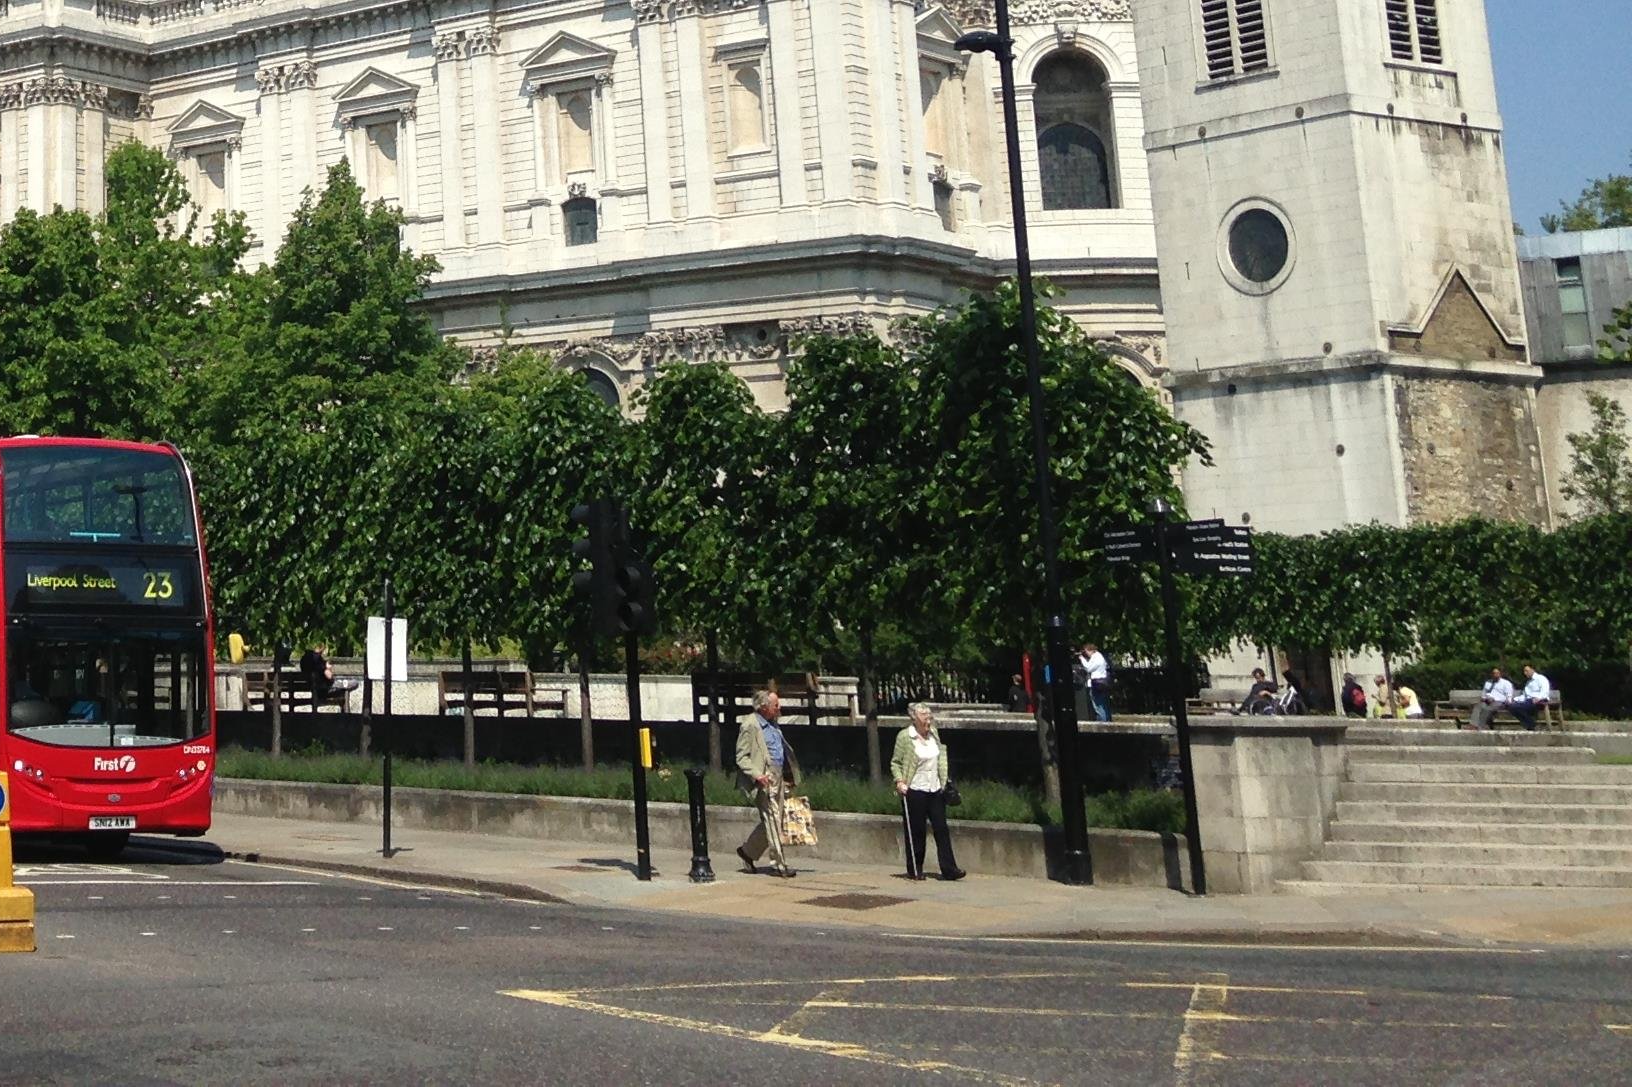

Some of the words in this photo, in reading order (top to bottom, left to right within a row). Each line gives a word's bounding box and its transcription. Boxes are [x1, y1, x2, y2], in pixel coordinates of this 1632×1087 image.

[27, 573, 78, 590] Liverpool
[83, 573, 116, 589] Street
[143, 572, 173, 599] 23
[94, 757, 119, 771] First
[95, 817, 112, 827] SN12
[115, 817, 130, 827] AWA
